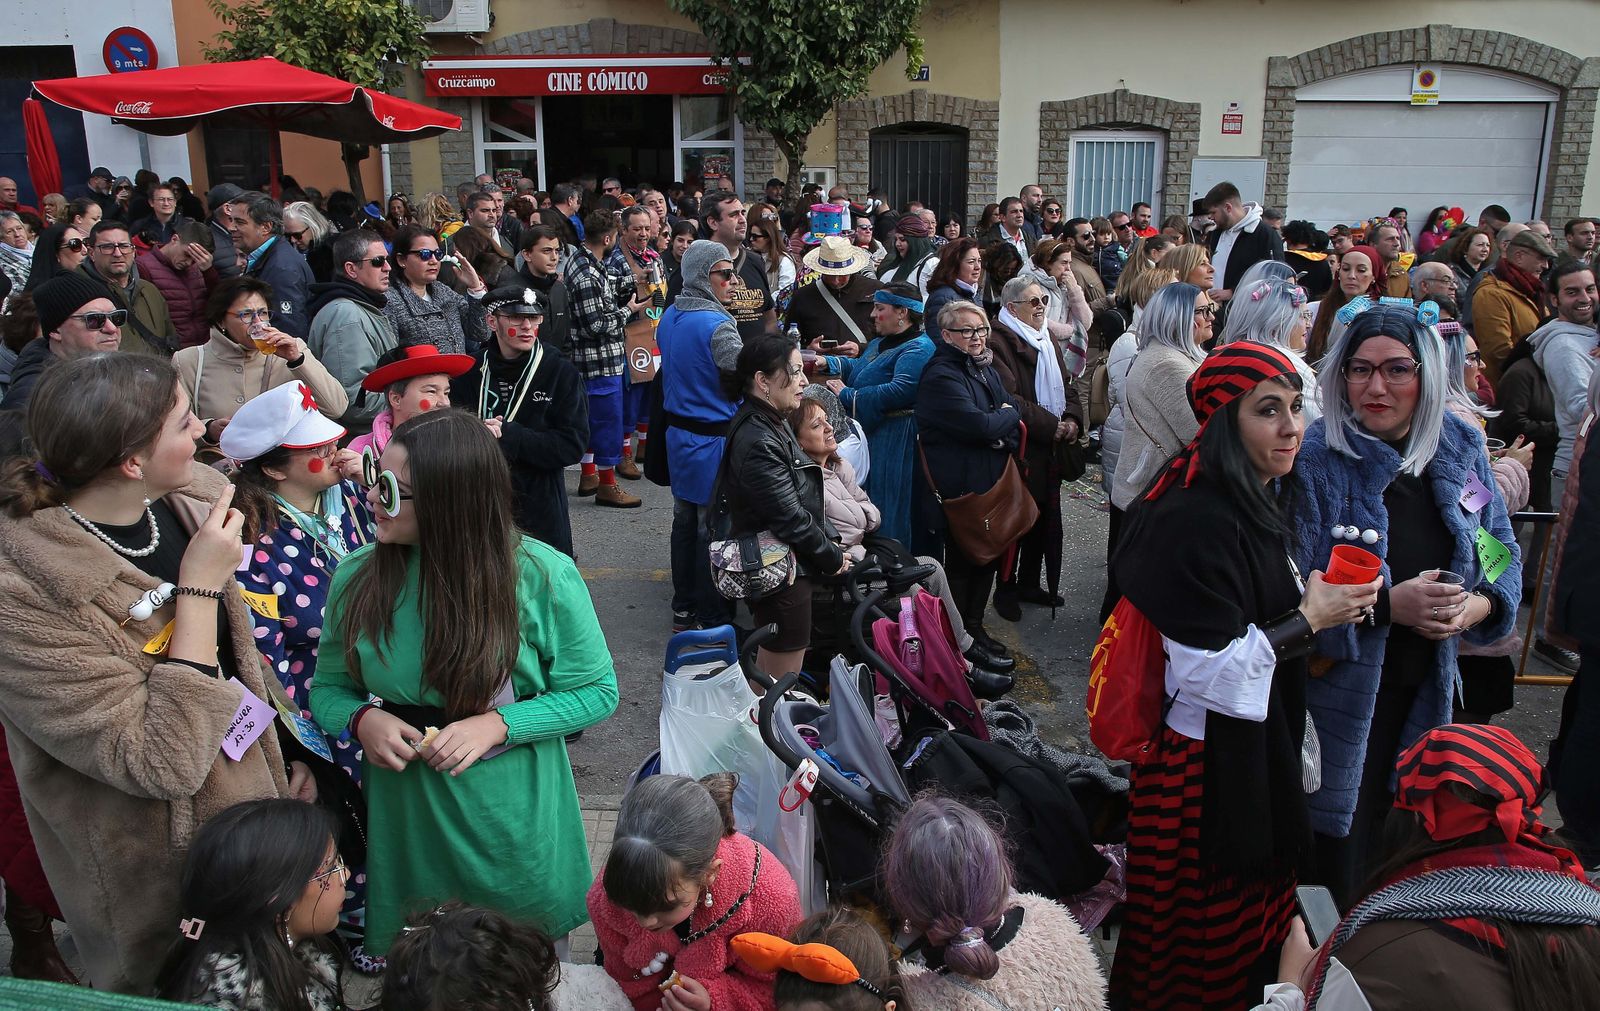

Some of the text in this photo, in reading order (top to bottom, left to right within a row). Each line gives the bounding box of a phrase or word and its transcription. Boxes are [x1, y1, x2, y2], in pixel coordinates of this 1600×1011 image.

[114, 59, 148, 68] 9 mts.
[438, 77, 496, 89] Cruzcampo
[547, 68, 648, 91] CINE CÓMICO
[223, 704, 253, 742] MANICURA
[233, 720, 255, 748] 17:30
